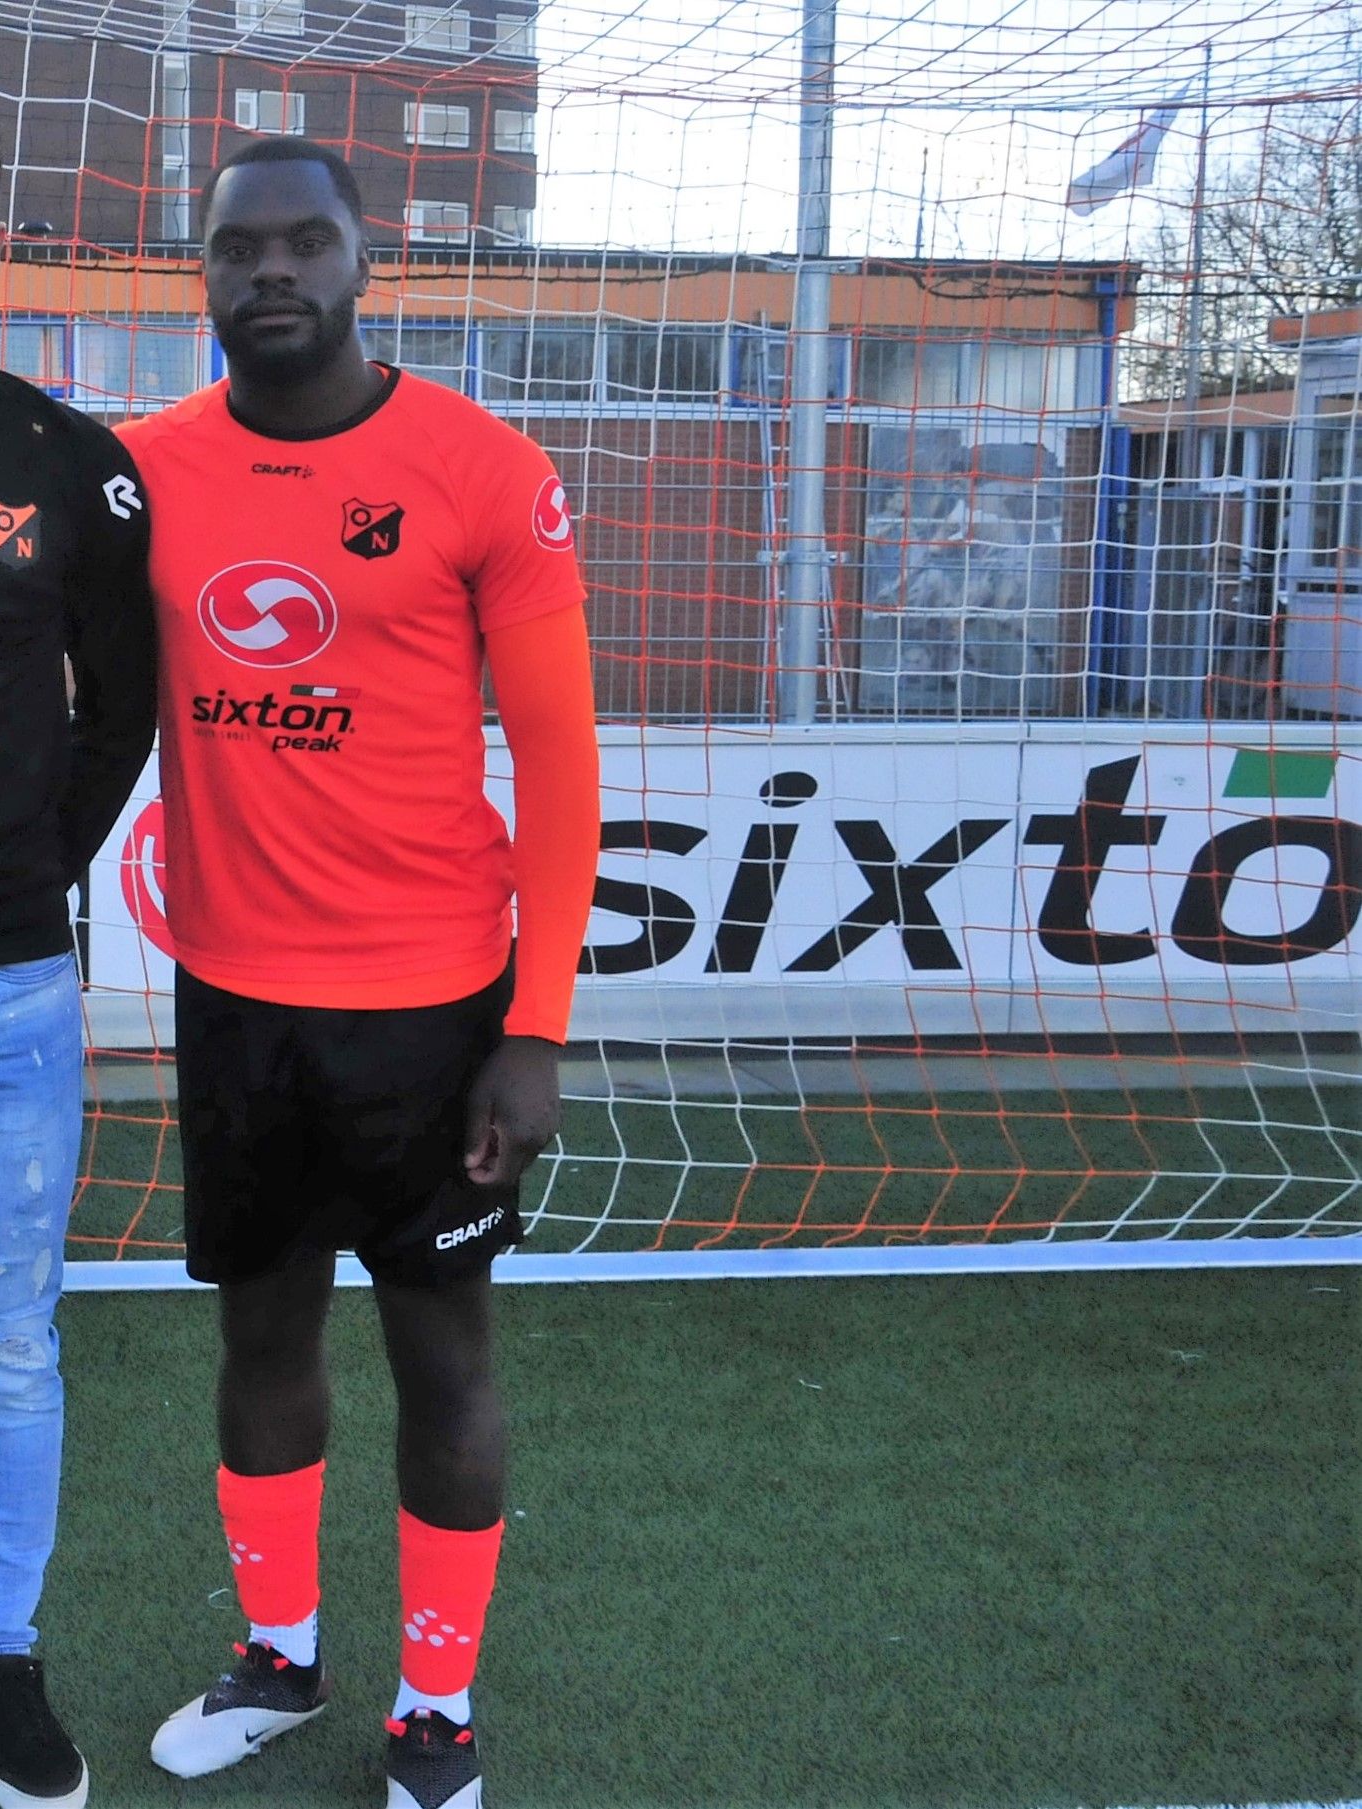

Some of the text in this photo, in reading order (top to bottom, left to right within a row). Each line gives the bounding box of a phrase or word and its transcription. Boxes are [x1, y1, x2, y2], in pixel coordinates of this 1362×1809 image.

[251, 463, 301, 477] CRAFT
[16, 536, 33, 558] N
[271, 734, 344, 753] peak
[435, 1211, 496, 1251] CRAFT
